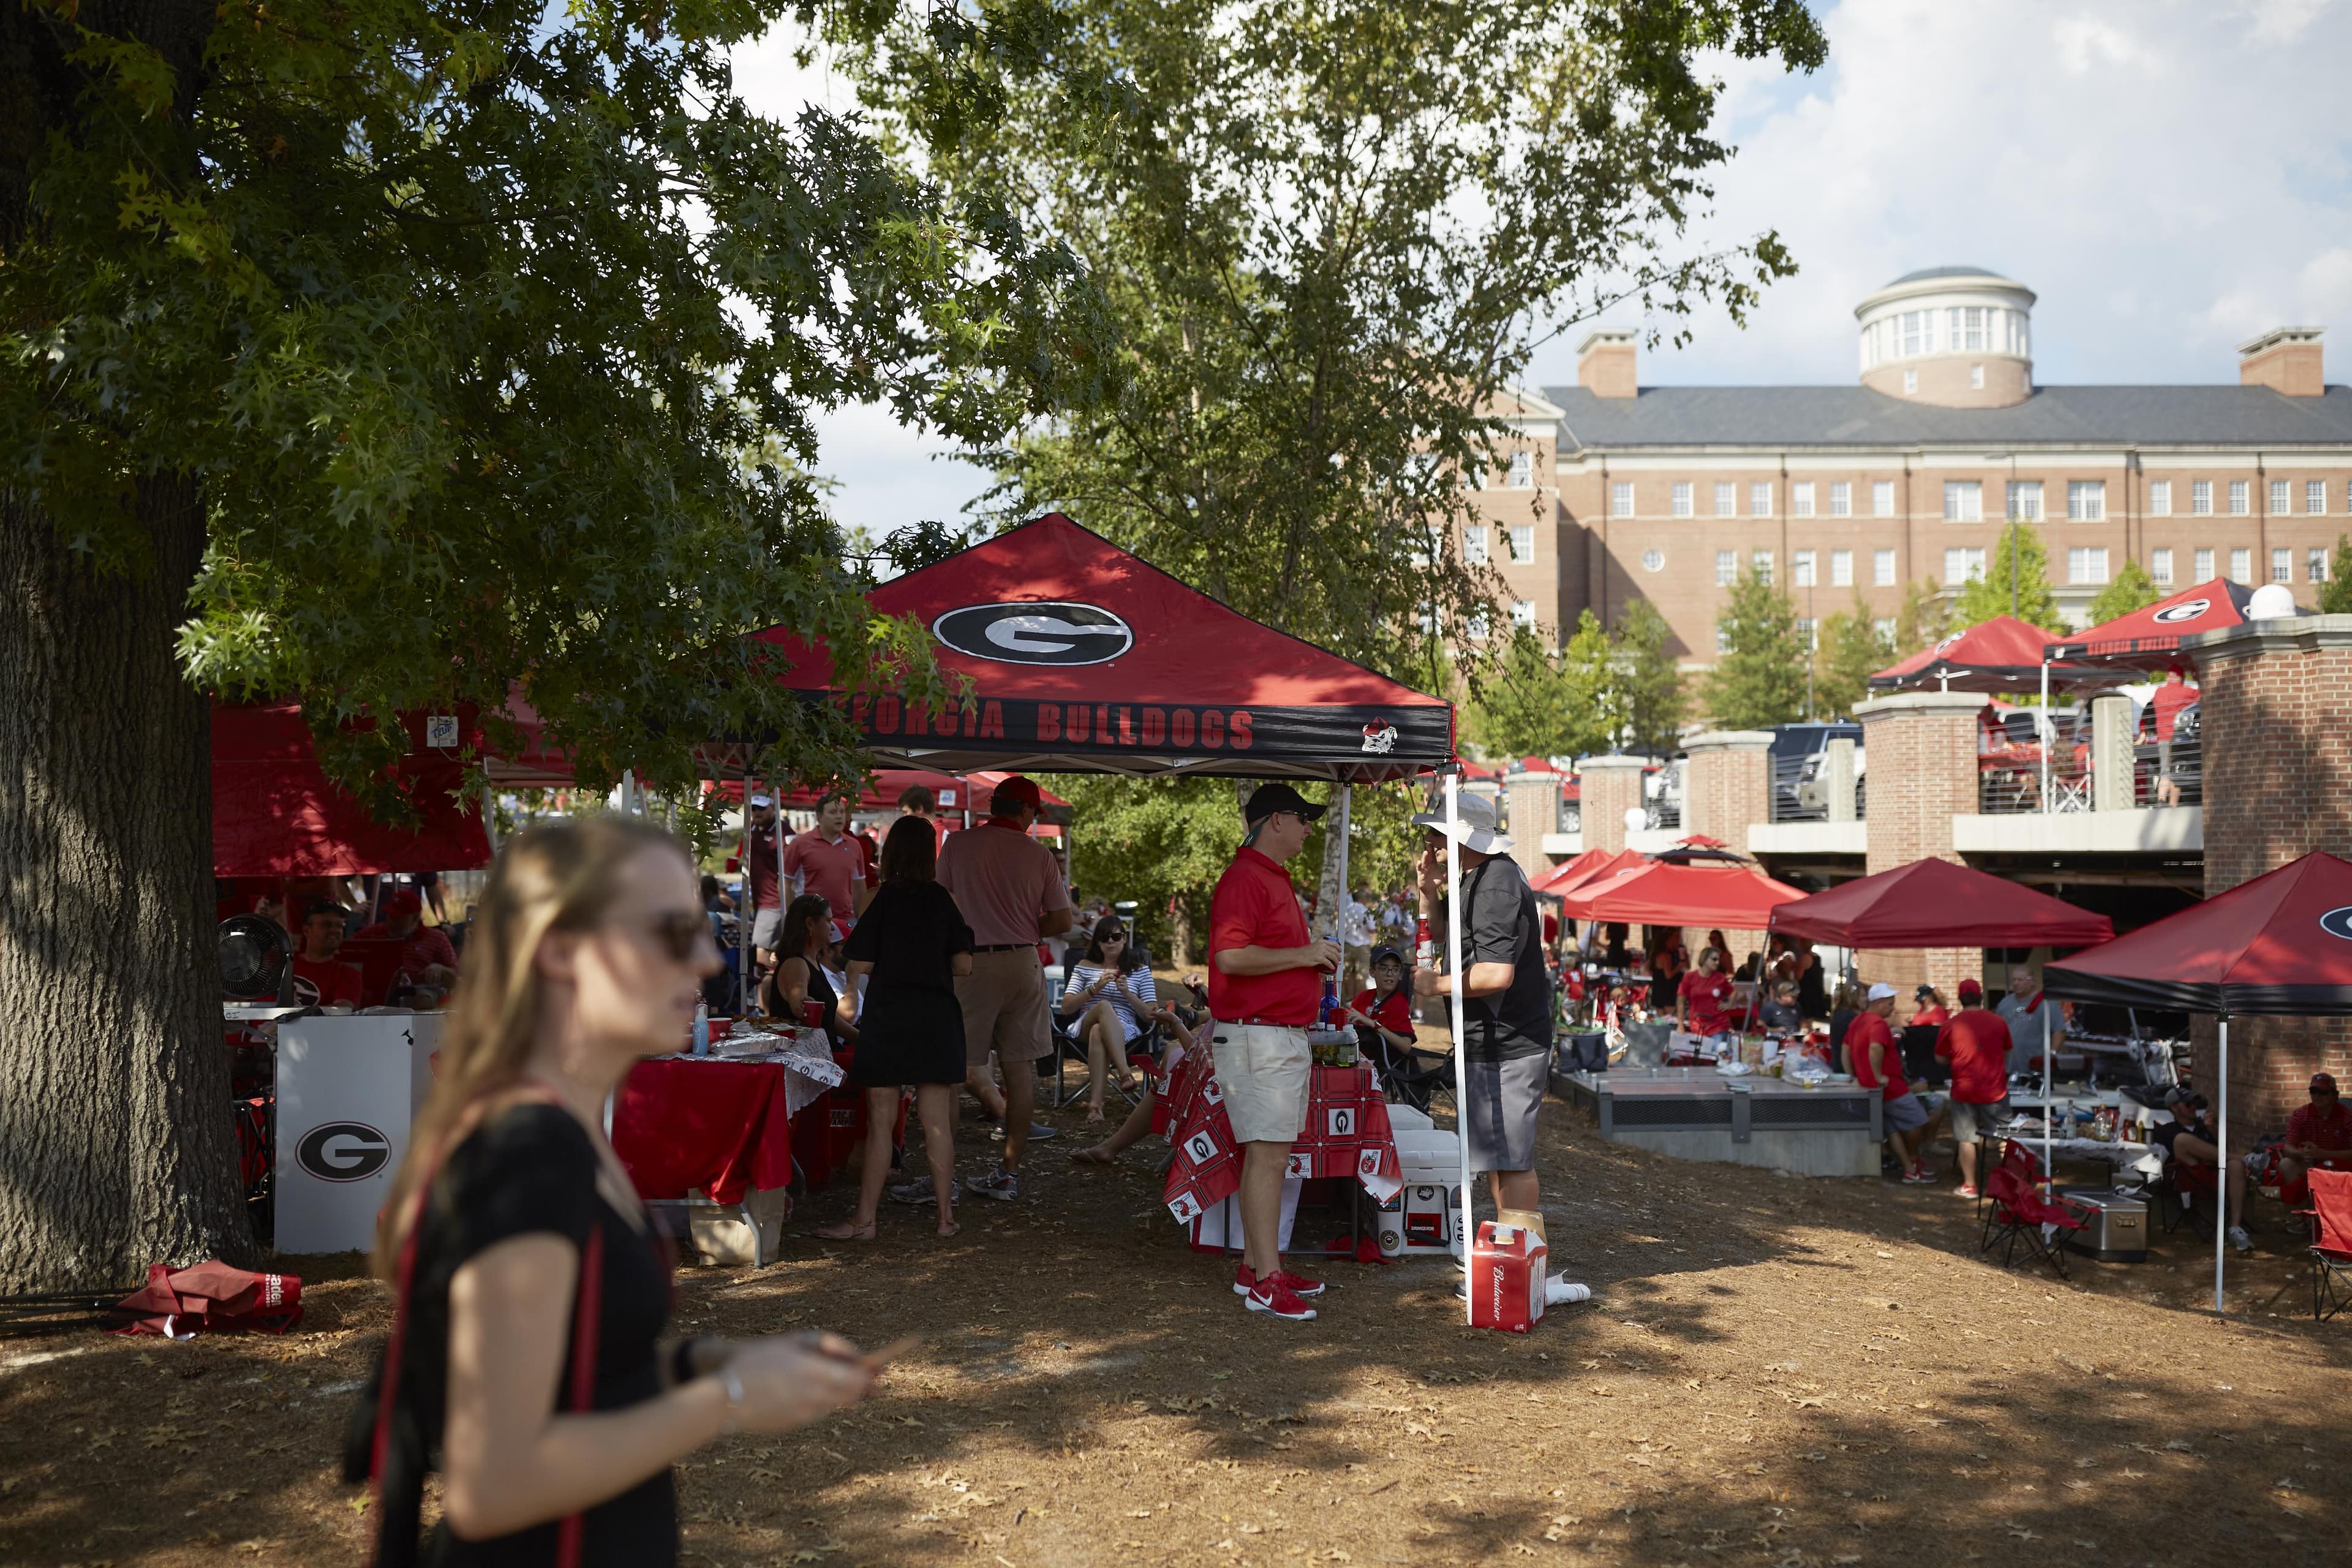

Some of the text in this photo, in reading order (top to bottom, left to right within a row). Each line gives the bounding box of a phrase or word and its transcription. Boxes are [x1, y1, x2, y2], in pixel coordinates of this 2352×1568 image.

[935, 603, 1133, 664] G
[1037, 703, 1253, 750] BULLDOGS
[300, 1125, 388, 1180] G
[1493, 1265, 1504, 1322] Budweiser
